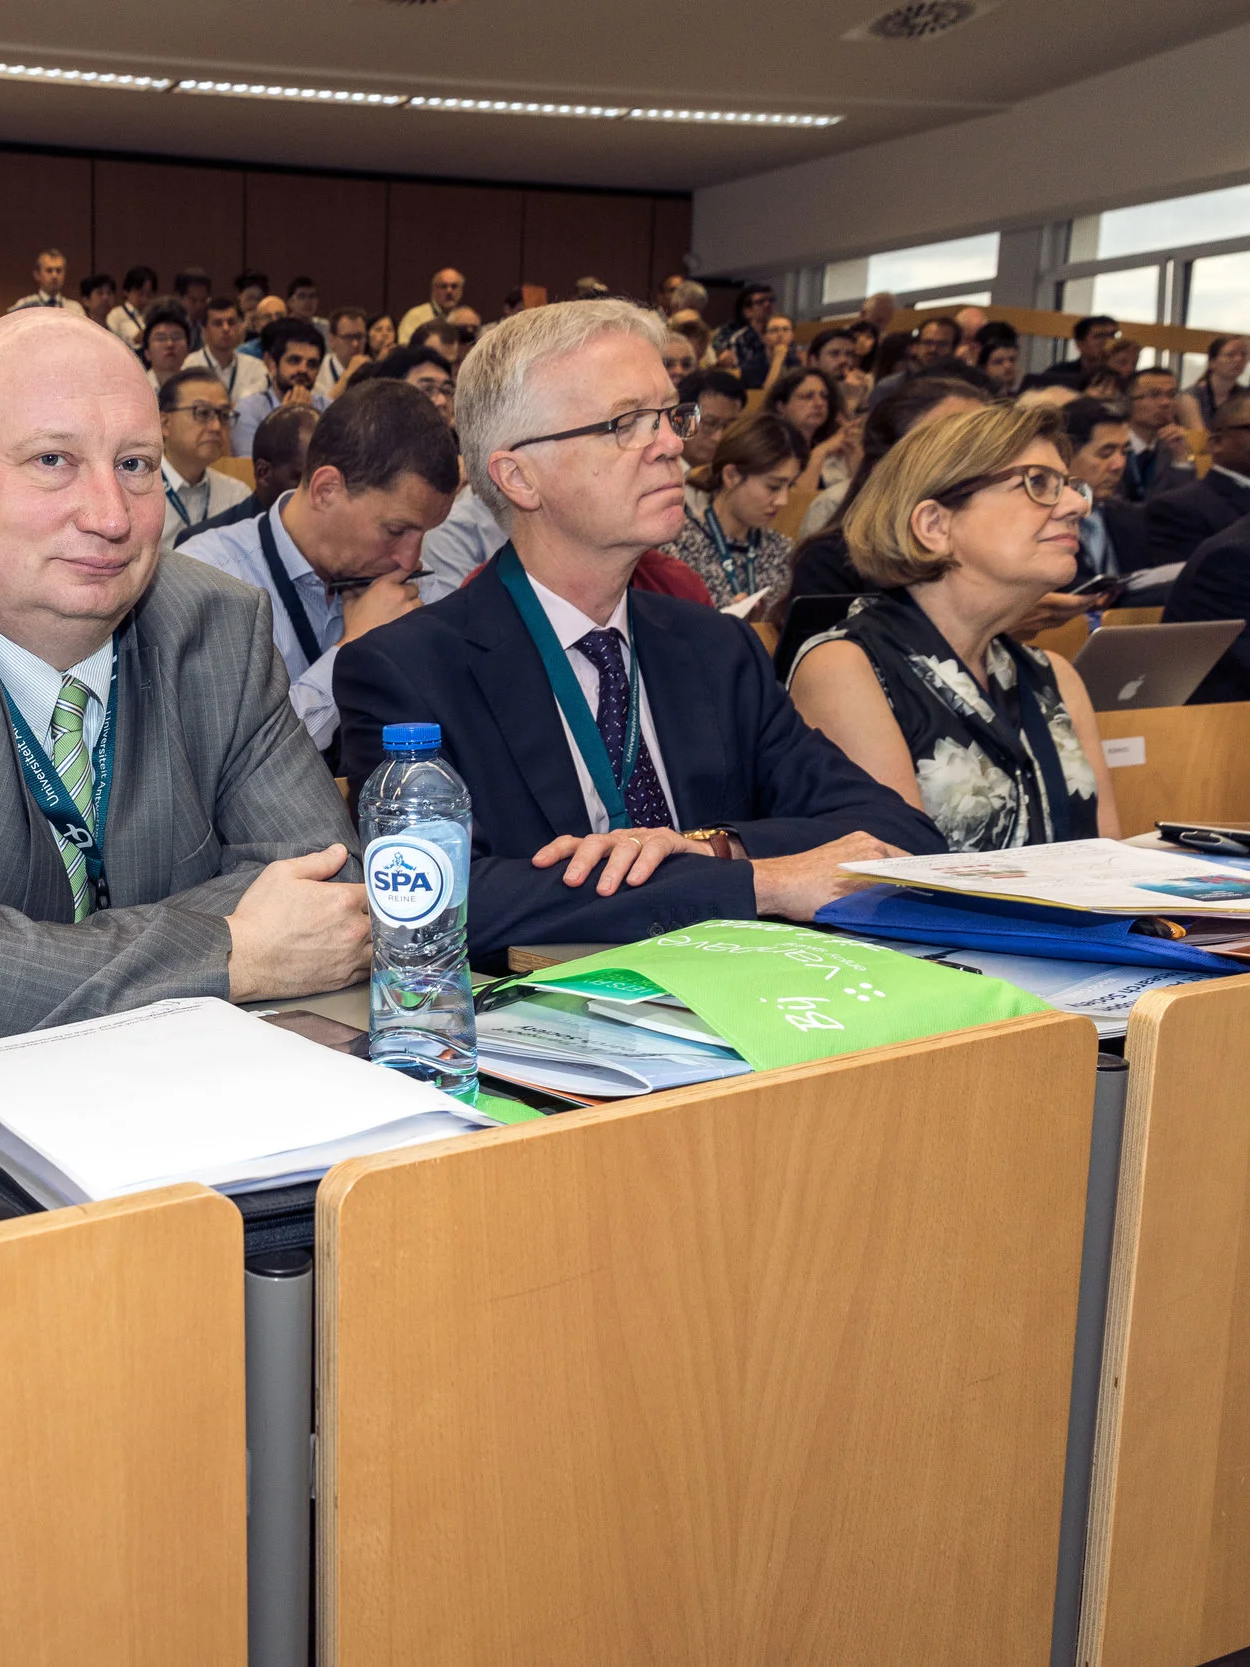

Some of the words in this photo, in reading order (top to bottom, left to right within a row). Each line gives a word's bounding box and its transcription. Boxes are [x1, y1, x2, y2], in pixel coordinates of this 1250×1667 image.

[97, 710, 112, 779] Universiteit
[17, 739, 59, 807] Universiteit
[374, 870, 433, 892] SPA
[388, 894, 416, 903] REINE
